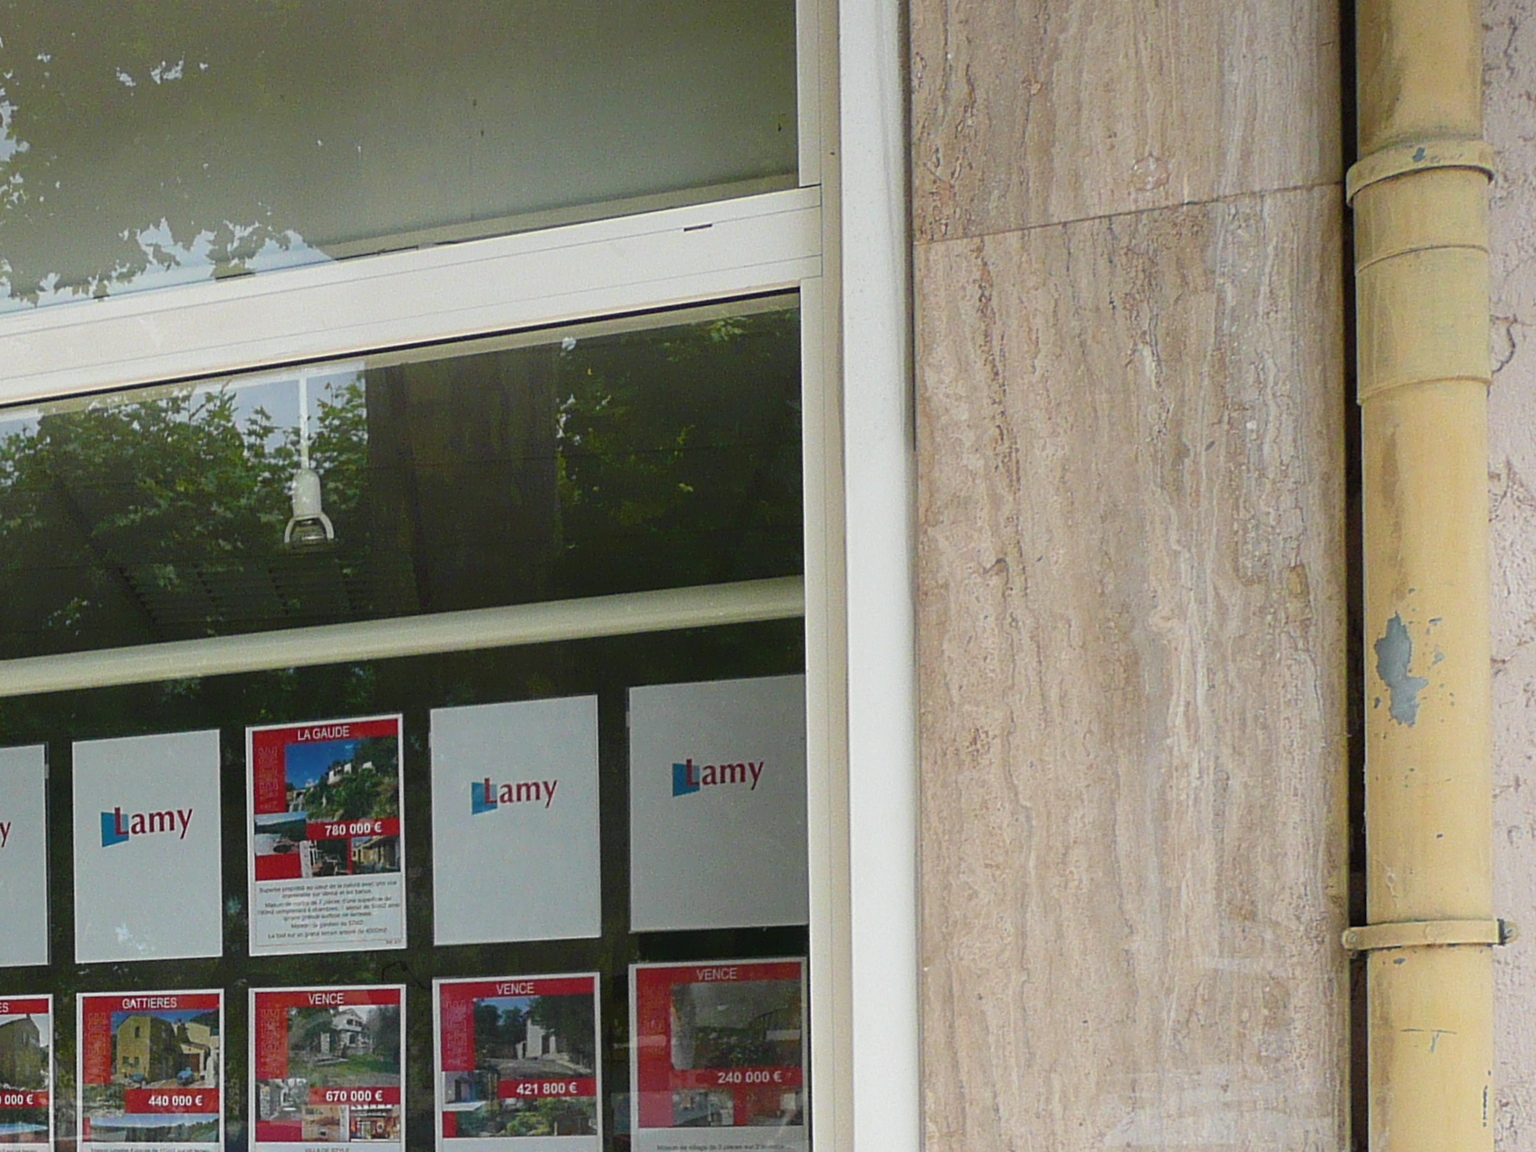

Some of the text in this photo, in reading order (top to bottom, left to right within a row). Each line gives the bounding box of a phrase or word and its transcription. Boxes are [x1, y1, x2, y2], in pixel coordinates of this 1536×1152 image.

[298, 726, 350, 741] LA GAUDE
[686, 759, 763, 791] Lamy
[484, 778, 557, 808] Lamy
[115, 807, 193, 839] Lamy
[325, 821, 382, 836] 780 000 €
[696, 968, 737, 980] VENCE
[496, 983, 535, 995] VENCE
[122, 998, 177, 1009] GATTIERES
[308, 992, 345, 1005] VENCE
[717, 1071, 782, 1084] 240 000 €
[516, 1082, 578, 1095] 421 800 €
[6, 1095, 25, 1105] 000
[26, 1094, 34, 1105] €
[148, 1094, 203, 1106] 440 000 €
[326, 1090, 383, 1102] 670 000 €
